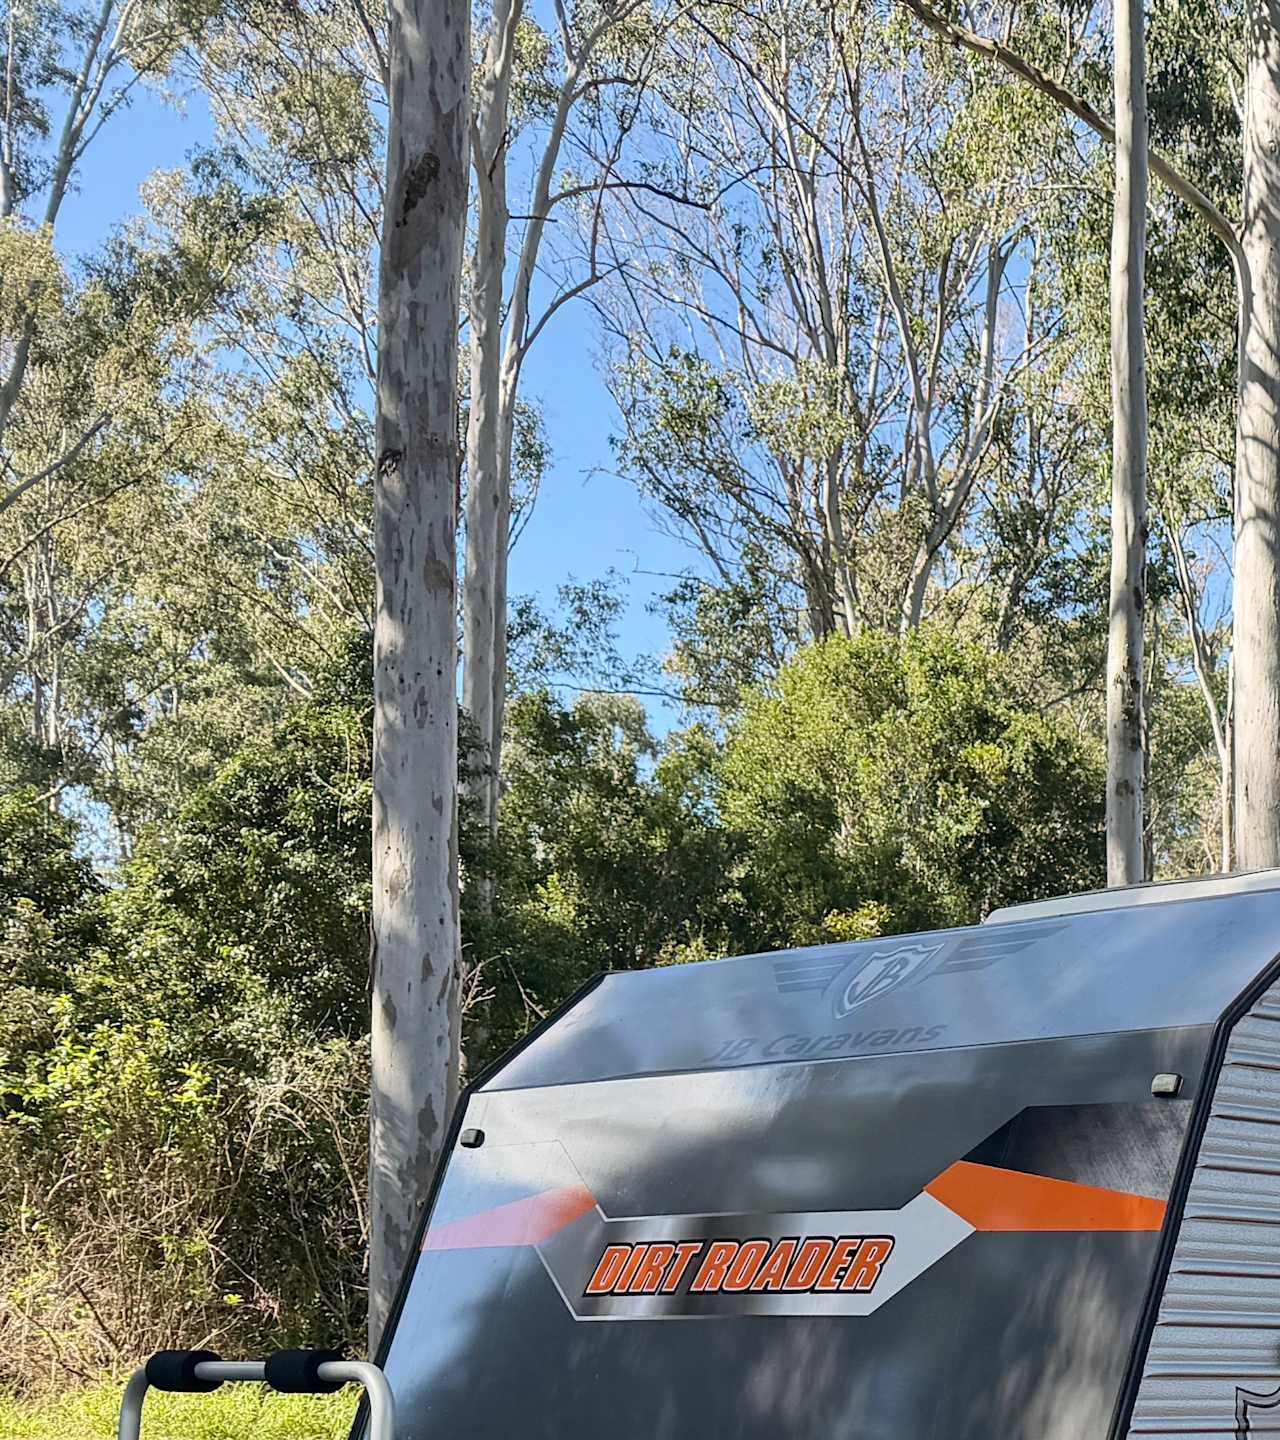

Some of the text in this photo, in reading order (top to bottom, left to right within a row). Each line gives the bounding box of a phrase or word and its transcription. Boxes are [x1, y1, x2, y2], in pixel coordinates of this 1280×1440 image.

[702, 1024, 949, 1065] JB Caravans
[584, 1235, 895, 1297] DIRT ROADER
